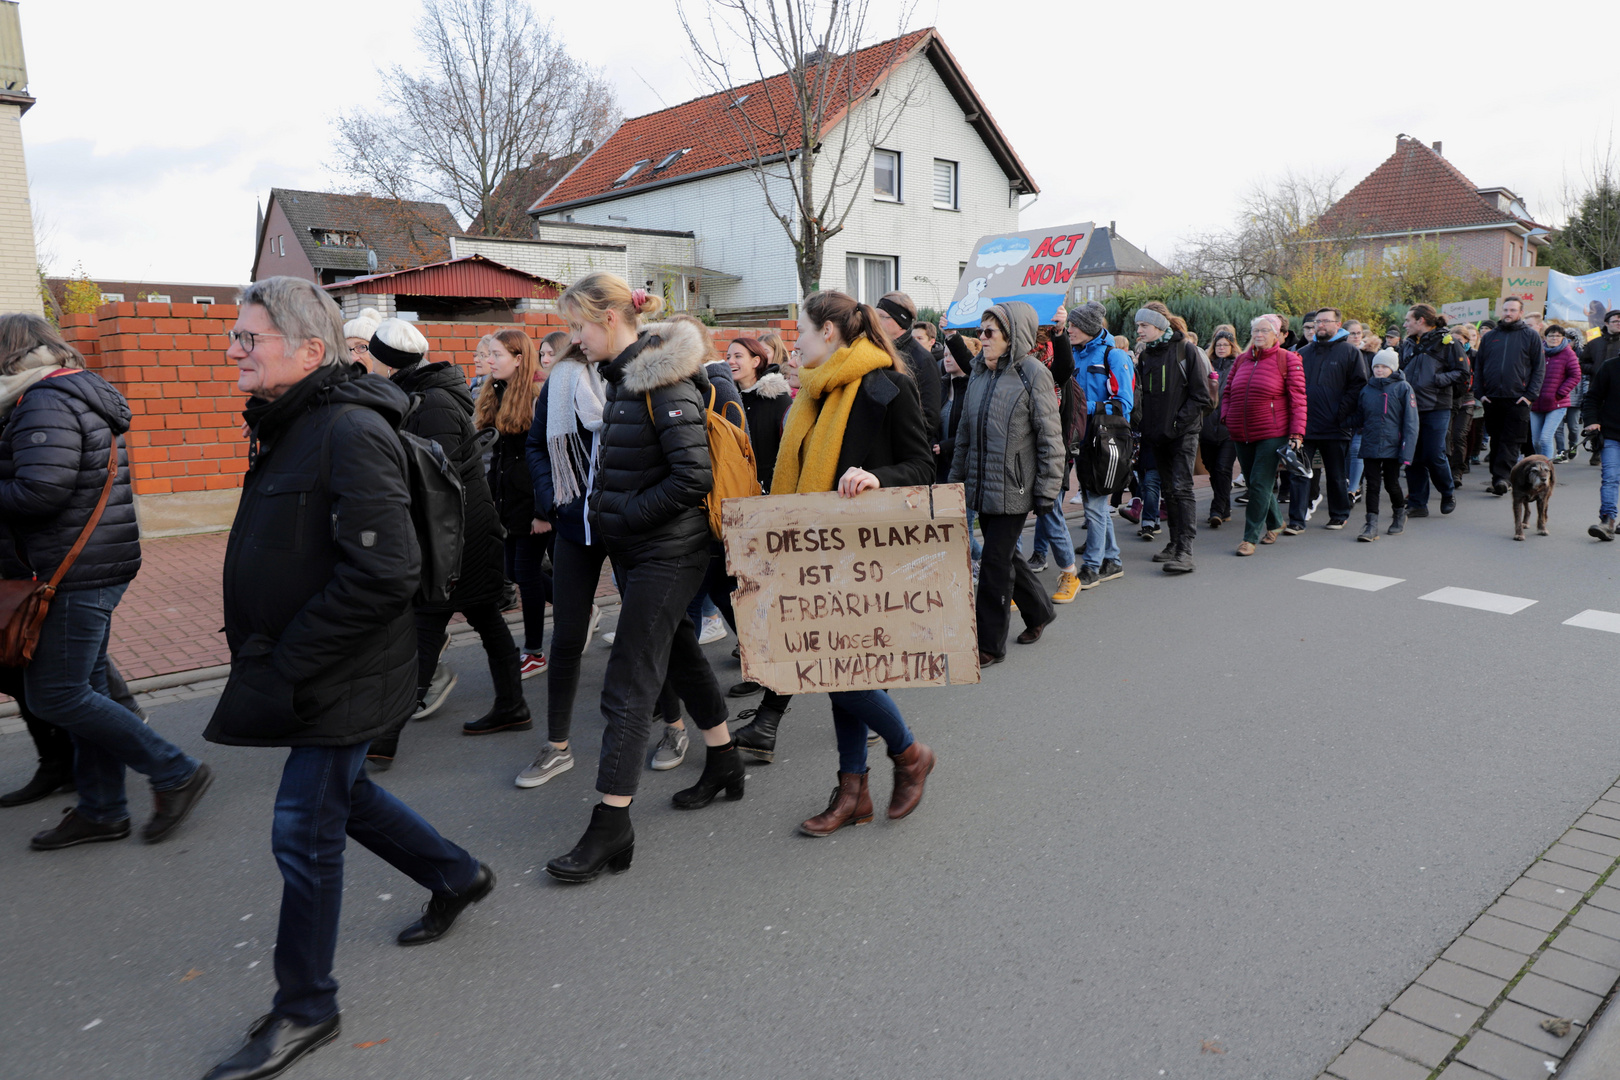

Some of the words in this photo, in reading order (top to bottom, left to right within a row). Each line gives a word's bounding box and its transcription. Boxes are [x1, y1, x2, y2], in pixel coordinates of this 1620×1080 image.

[1032, 234, 1084, 258] ACT
[1022, 257, 1081, 287] NOW
[1507, 277, 1545, 288] Wetter
[765, 527, 846, 554] DIESES
[858, 524, 955, 549] PLAKAT
[799, 564, 834, 586] IST
[852, 560, 884, 583] SO
[778, 590, 945, 622] ERBÄRMLICH
[784, 630, 820, 653] WIE
[795, 651, 947, 691] KLIMAPOLITIK
